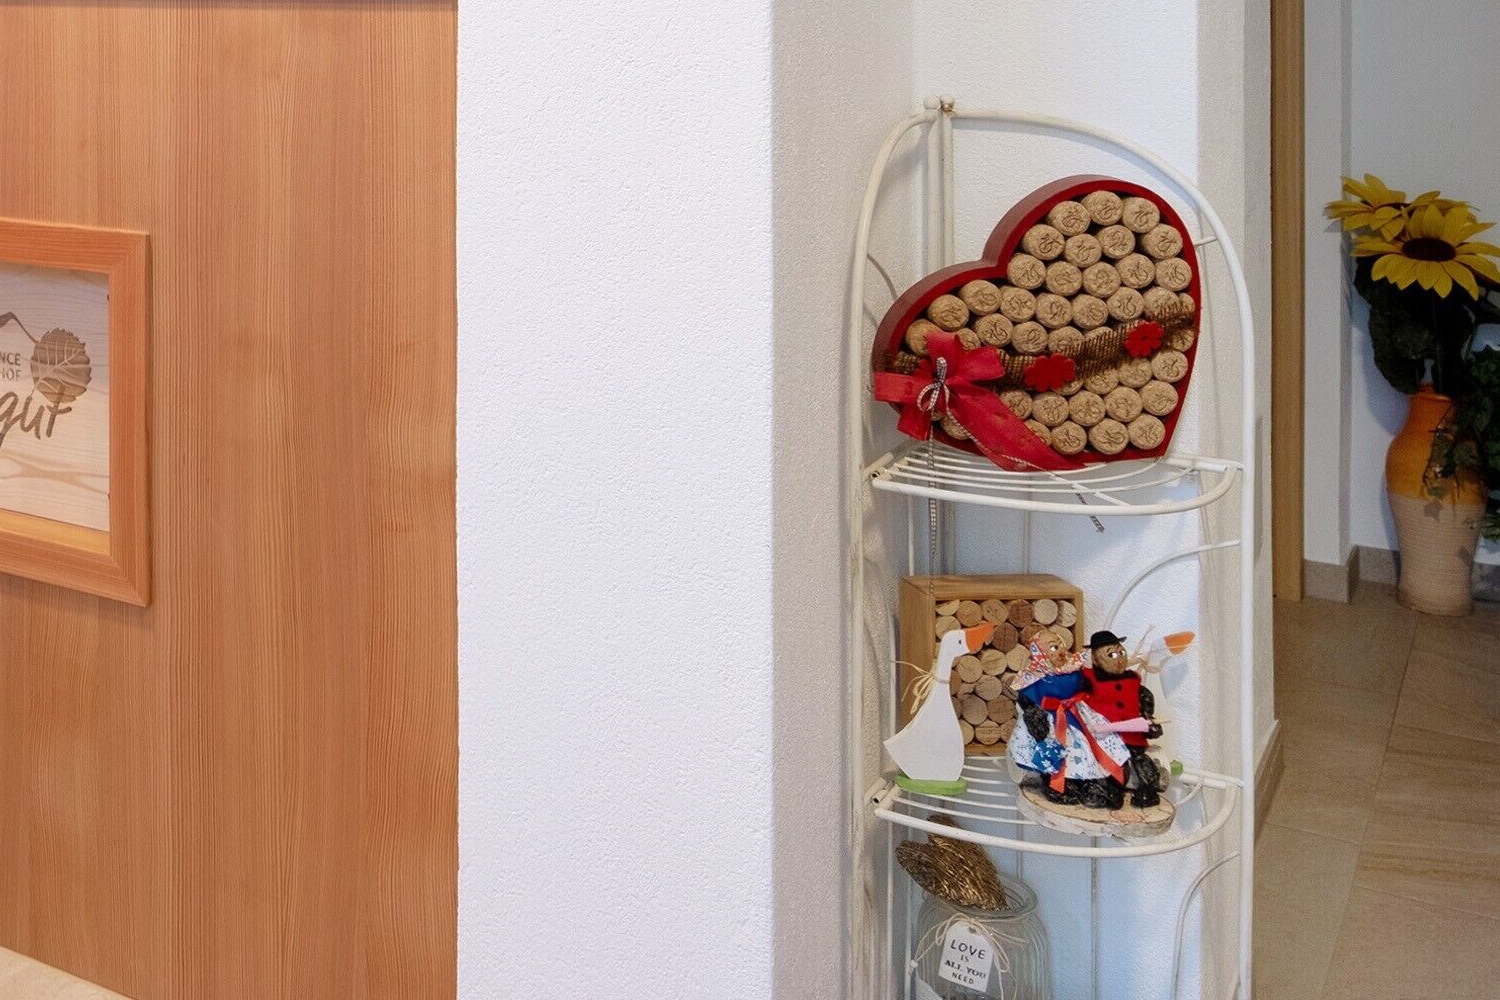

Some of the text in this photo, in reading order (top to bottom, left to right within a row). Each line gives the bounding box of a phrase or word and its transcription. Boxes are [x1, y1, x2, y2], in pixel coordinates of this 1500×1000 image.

[950, 939, 986, 960] LOVE
[960, 955, 970, 963] IS
[944, 959, 987, 979] ALL YOU
[952, 971, 974, 985] NEED
